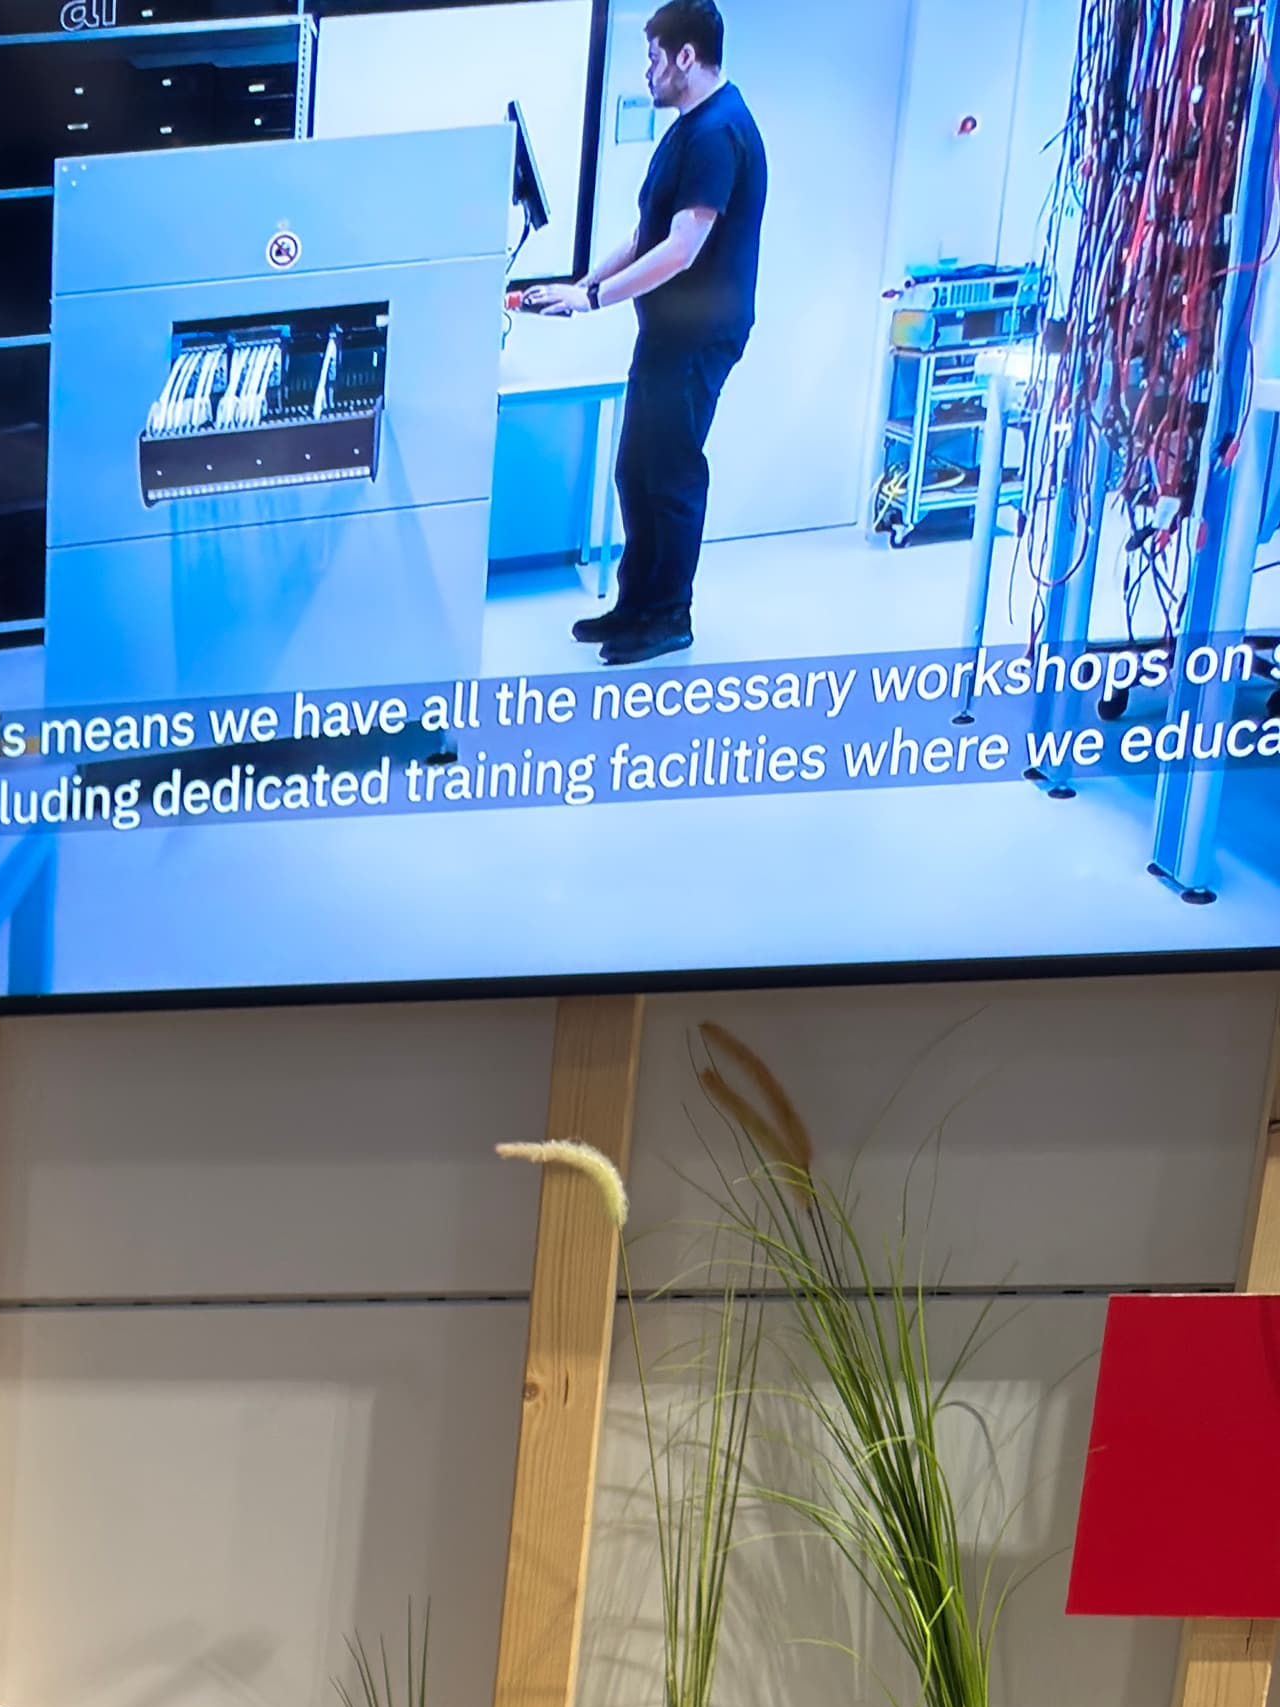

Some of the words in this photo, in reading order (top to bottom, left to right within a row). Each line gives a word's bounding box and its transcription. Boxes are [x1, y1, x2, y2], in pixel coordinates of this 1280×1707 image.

[41, 710, 195, 755] means
[209, 705, 278, 744] we
[293, 692, 407, 740] have
[421, 680, 481, 731] all
[495, 677, 577, 726] the
[592, 668, 857, 719] necessary
[871, 643, 1169, 702] workshops
[1185, 644, 1253, 685] on
[152, 755, 391, 817] dedicated
[405, 748, 597, 806] training
[609, 735, 827, 792] facilities
[844, 727, 1009, 777] where
[1026, 728, 1104, 767] we
